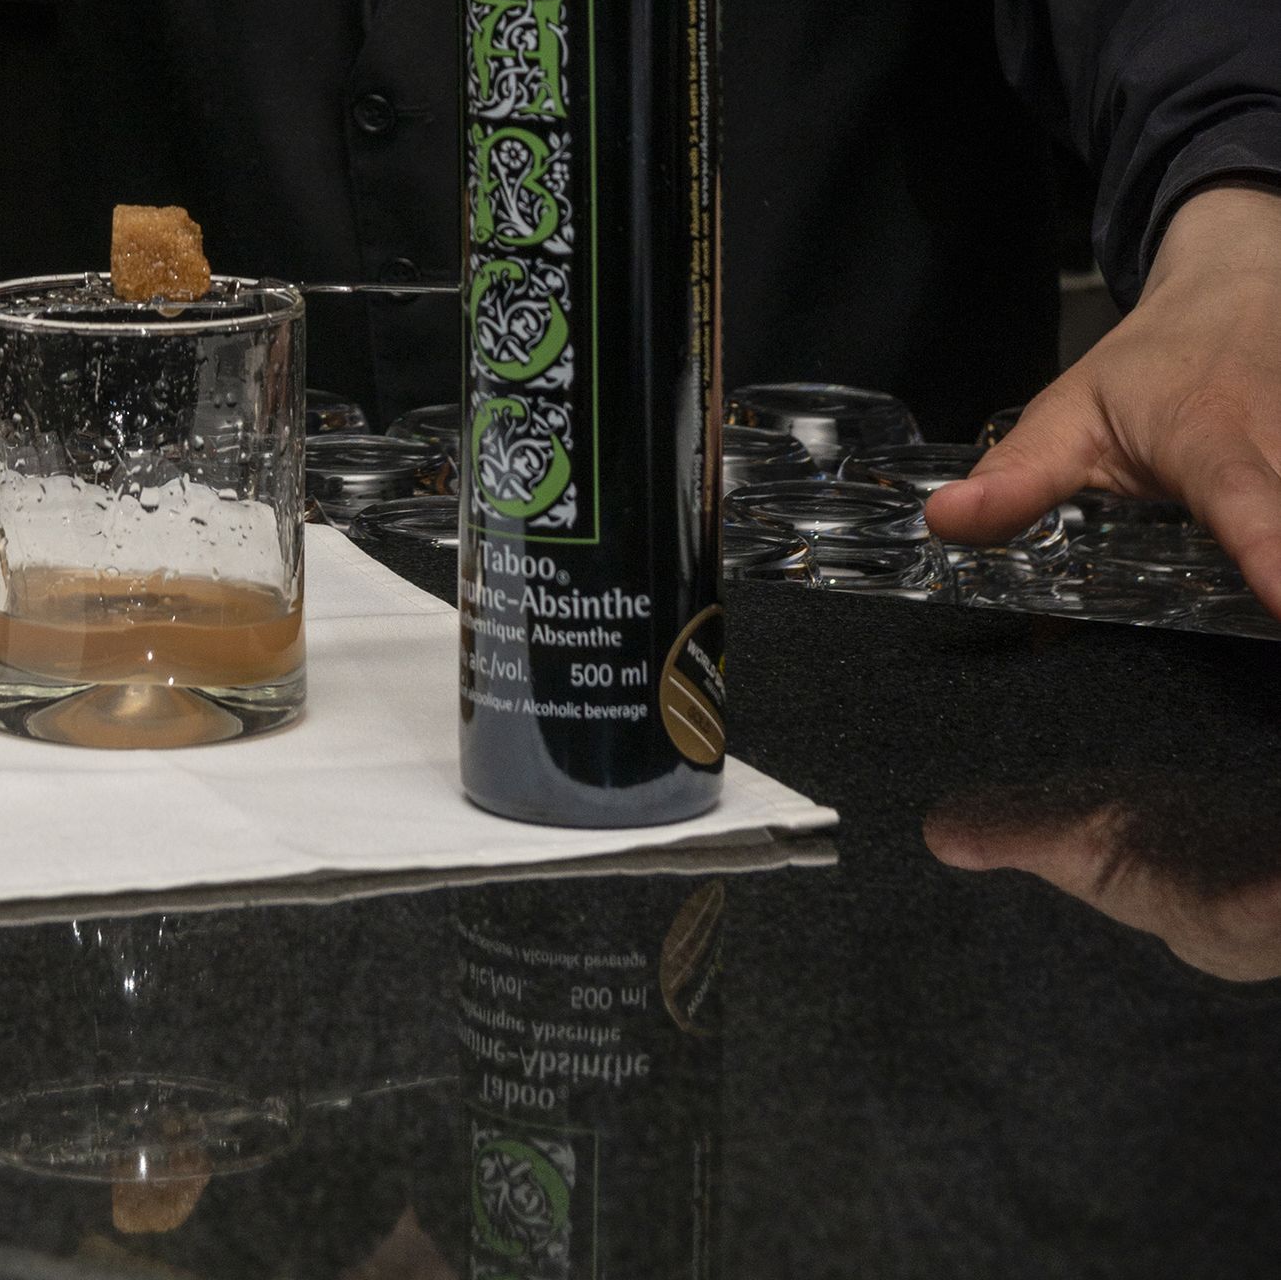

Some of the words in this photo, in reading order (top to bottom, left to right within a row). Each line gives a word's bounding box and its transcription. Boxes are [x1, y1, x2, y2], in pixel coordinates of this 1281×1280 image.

[531, 623, 623, 648] Absenthe
[570, 662, 613, 687] 500
[621, 660, 648, 686] ml
[522, 697, 582, 719] Alcoholic
[584, 699, 648, 722] beverage
